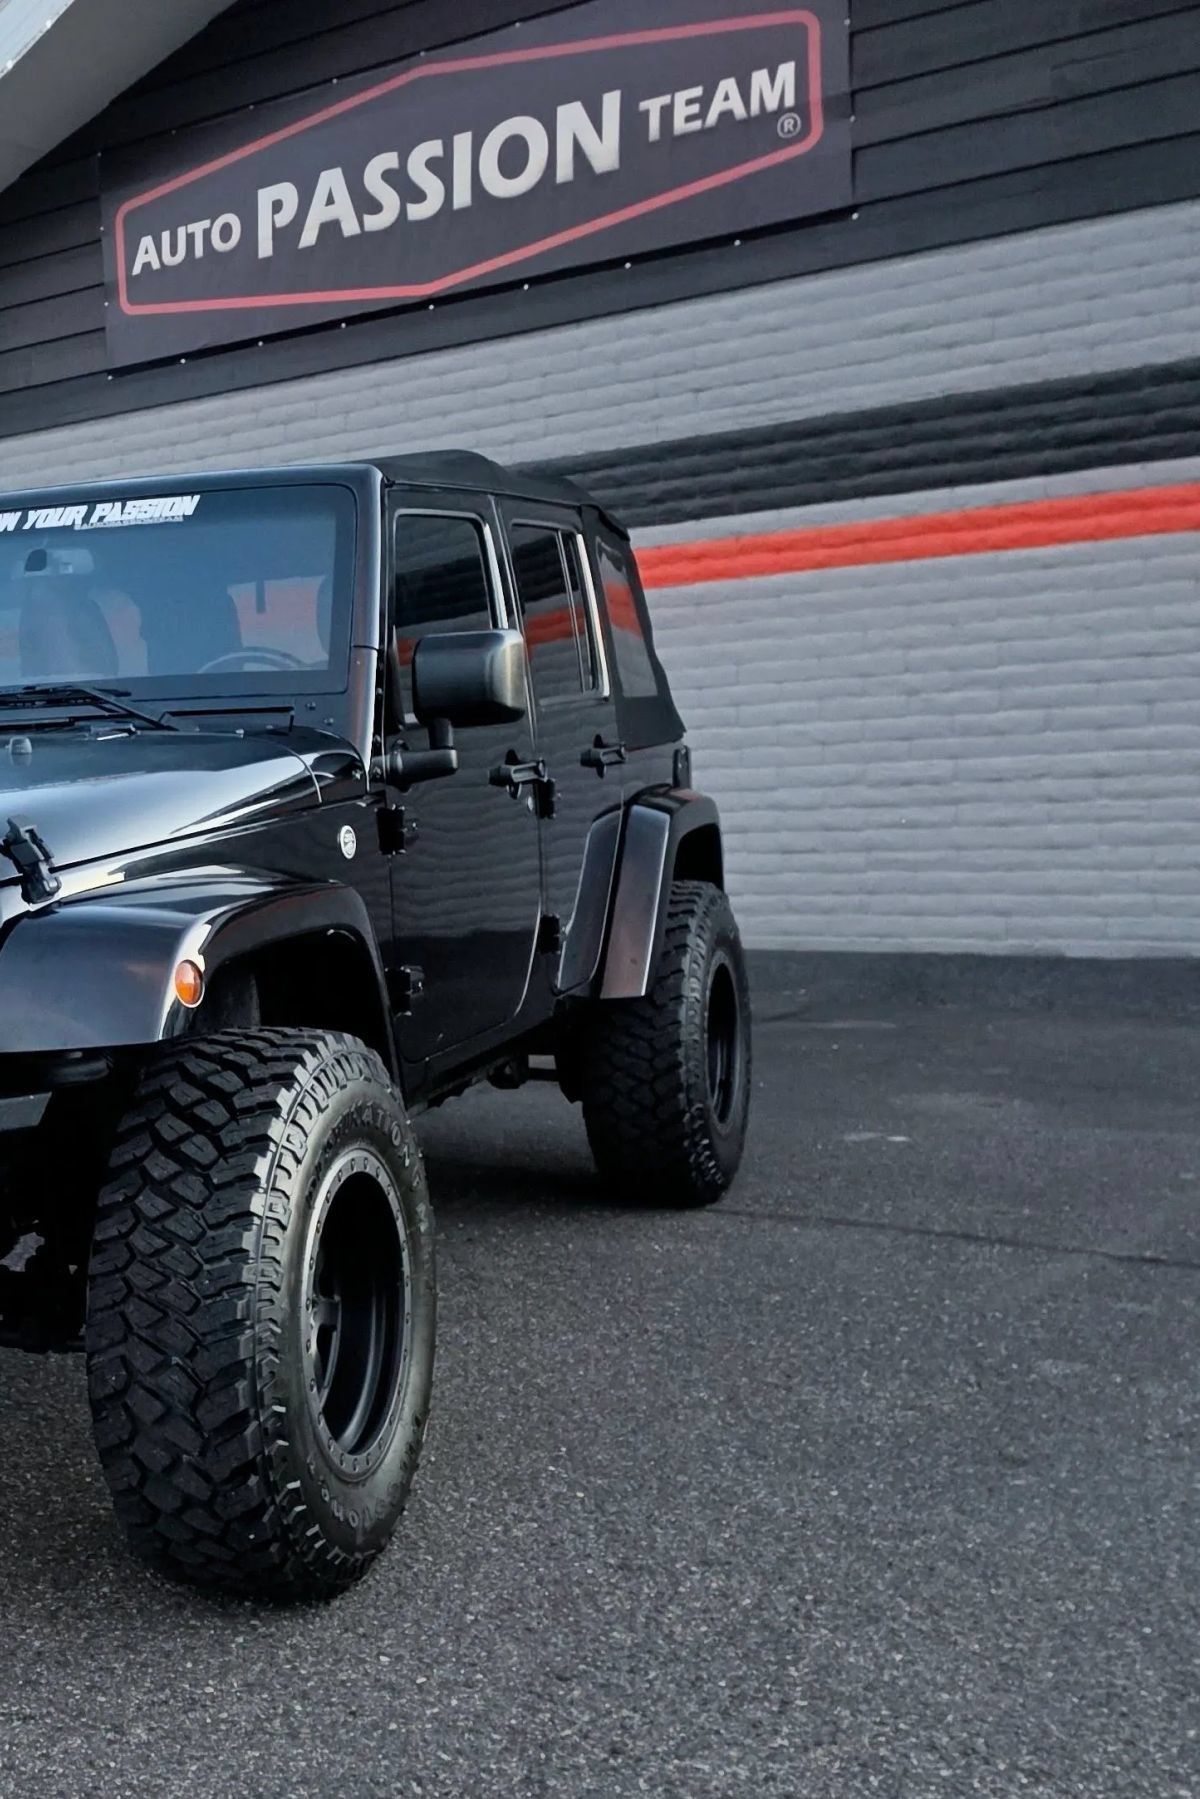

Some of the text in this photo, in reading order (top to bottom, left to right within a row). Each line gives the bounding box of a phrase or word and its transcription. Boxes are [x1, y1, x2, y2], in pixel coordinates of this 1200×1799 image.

[132, 61, 796, 275] AUTO PASSION TEAM
[22, 505, 89, 530] YOUR
[88, 494, 201, 525] PASSION
